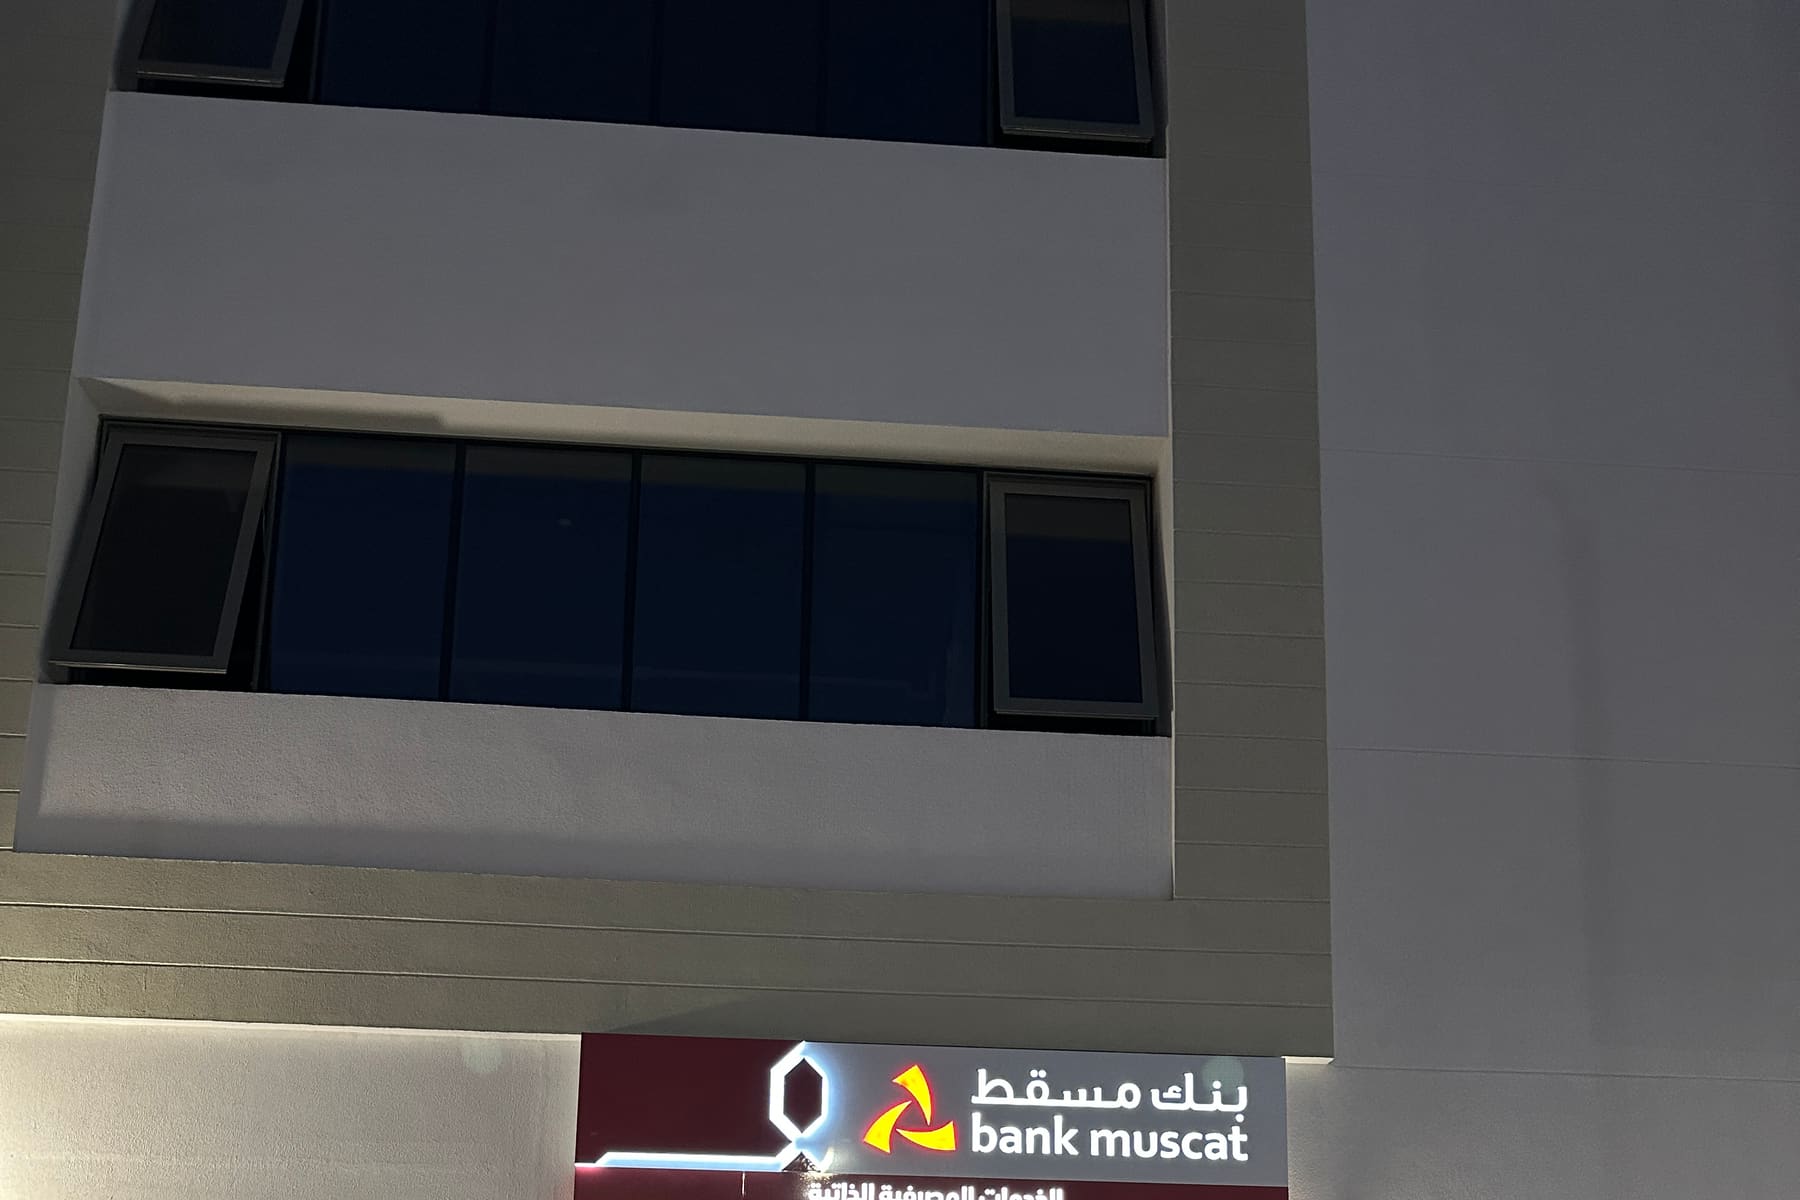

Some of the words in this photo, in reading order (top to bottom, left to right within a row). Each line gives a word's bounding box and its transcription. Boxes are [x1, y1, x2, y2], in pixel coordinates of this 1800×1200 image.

[971, 1068, 1141, 1109] مسقط
[1150, 1072, 1248, 1123] بنك
[971, 1111, 1079, 1155] bank
[1090, 1125, 1249, 1161] muscat
